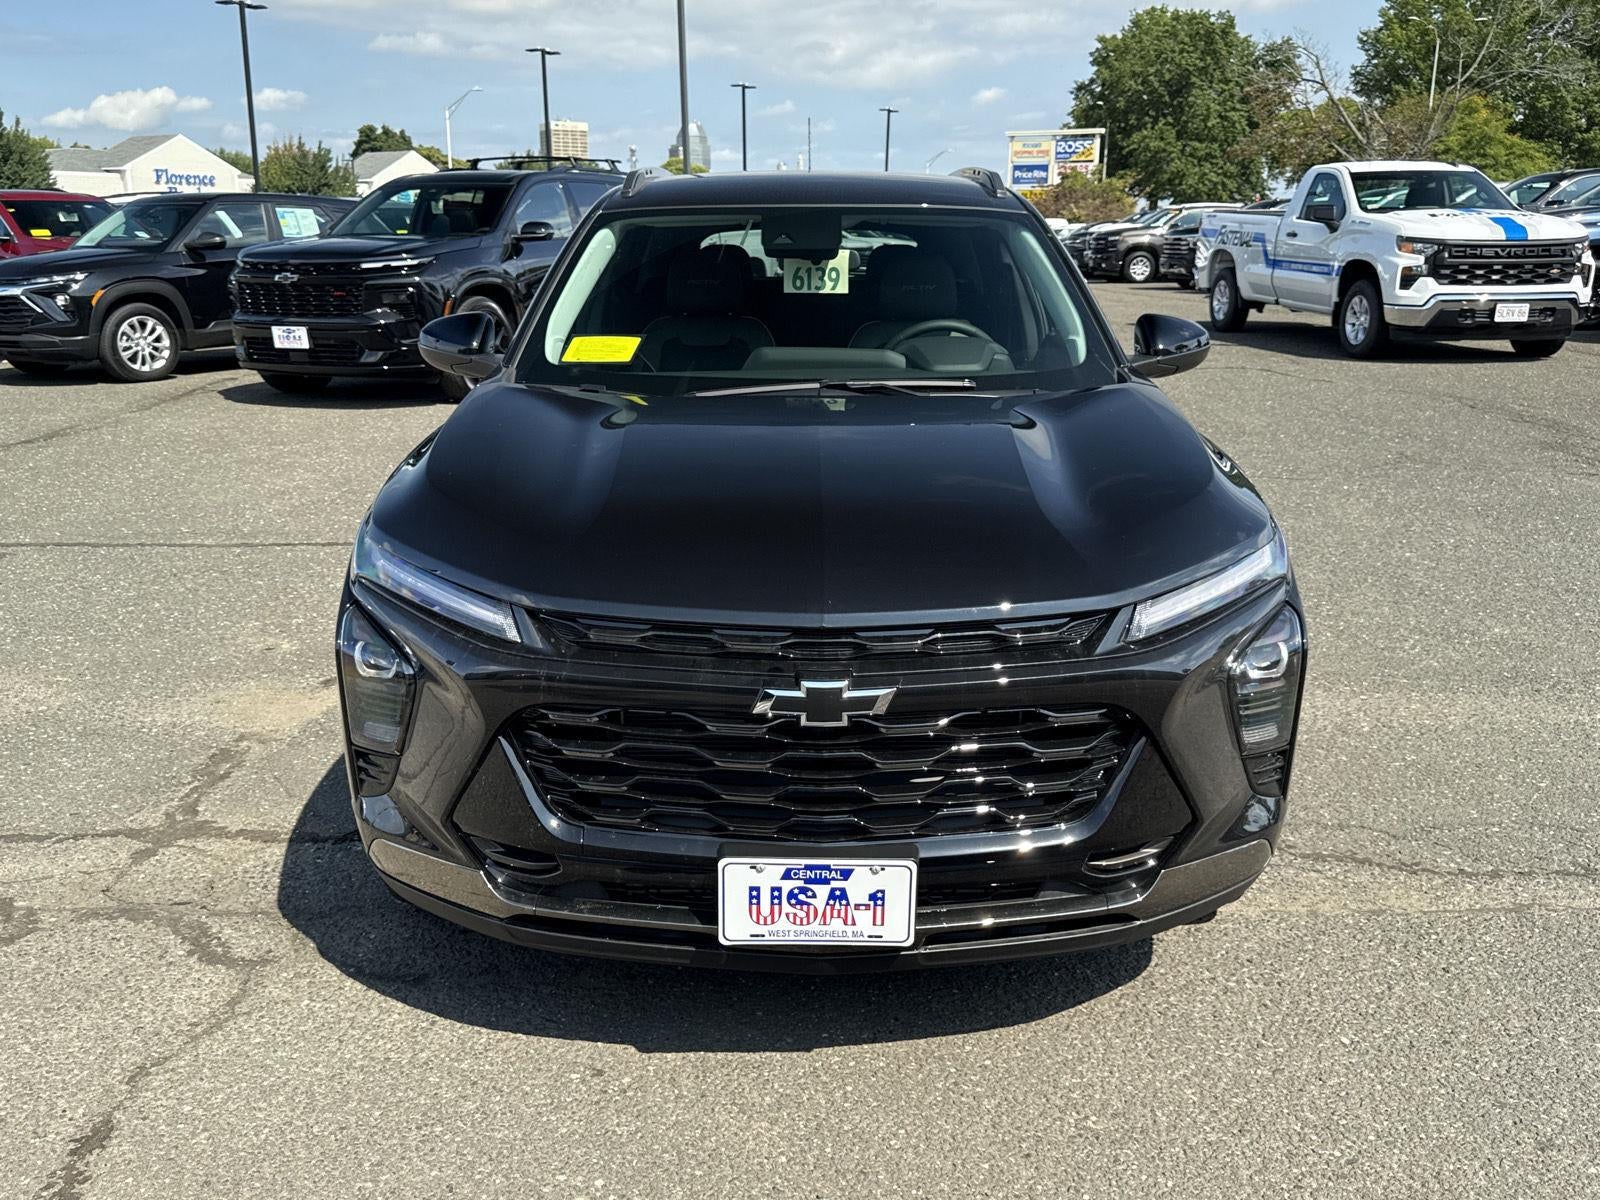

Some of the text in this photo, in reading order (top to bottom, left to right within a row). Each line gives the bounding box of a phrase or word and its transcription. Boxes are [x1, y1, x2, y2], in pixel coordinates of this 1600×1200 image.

[1056, 140, 1093, 153] ROSS
[154, 168, 216, 187] Florence
[1014, 170, 1032, 178] Price
[1451, 247, 1574, 256] CHEVROLET
[792, 266, 840, 291] 6139
[790, 869, 844, 880] CENTRAL
[748, 886, 886, 926] USA-1
[768, 929, 865, 939] WEST SPRINGFIELD, MA
